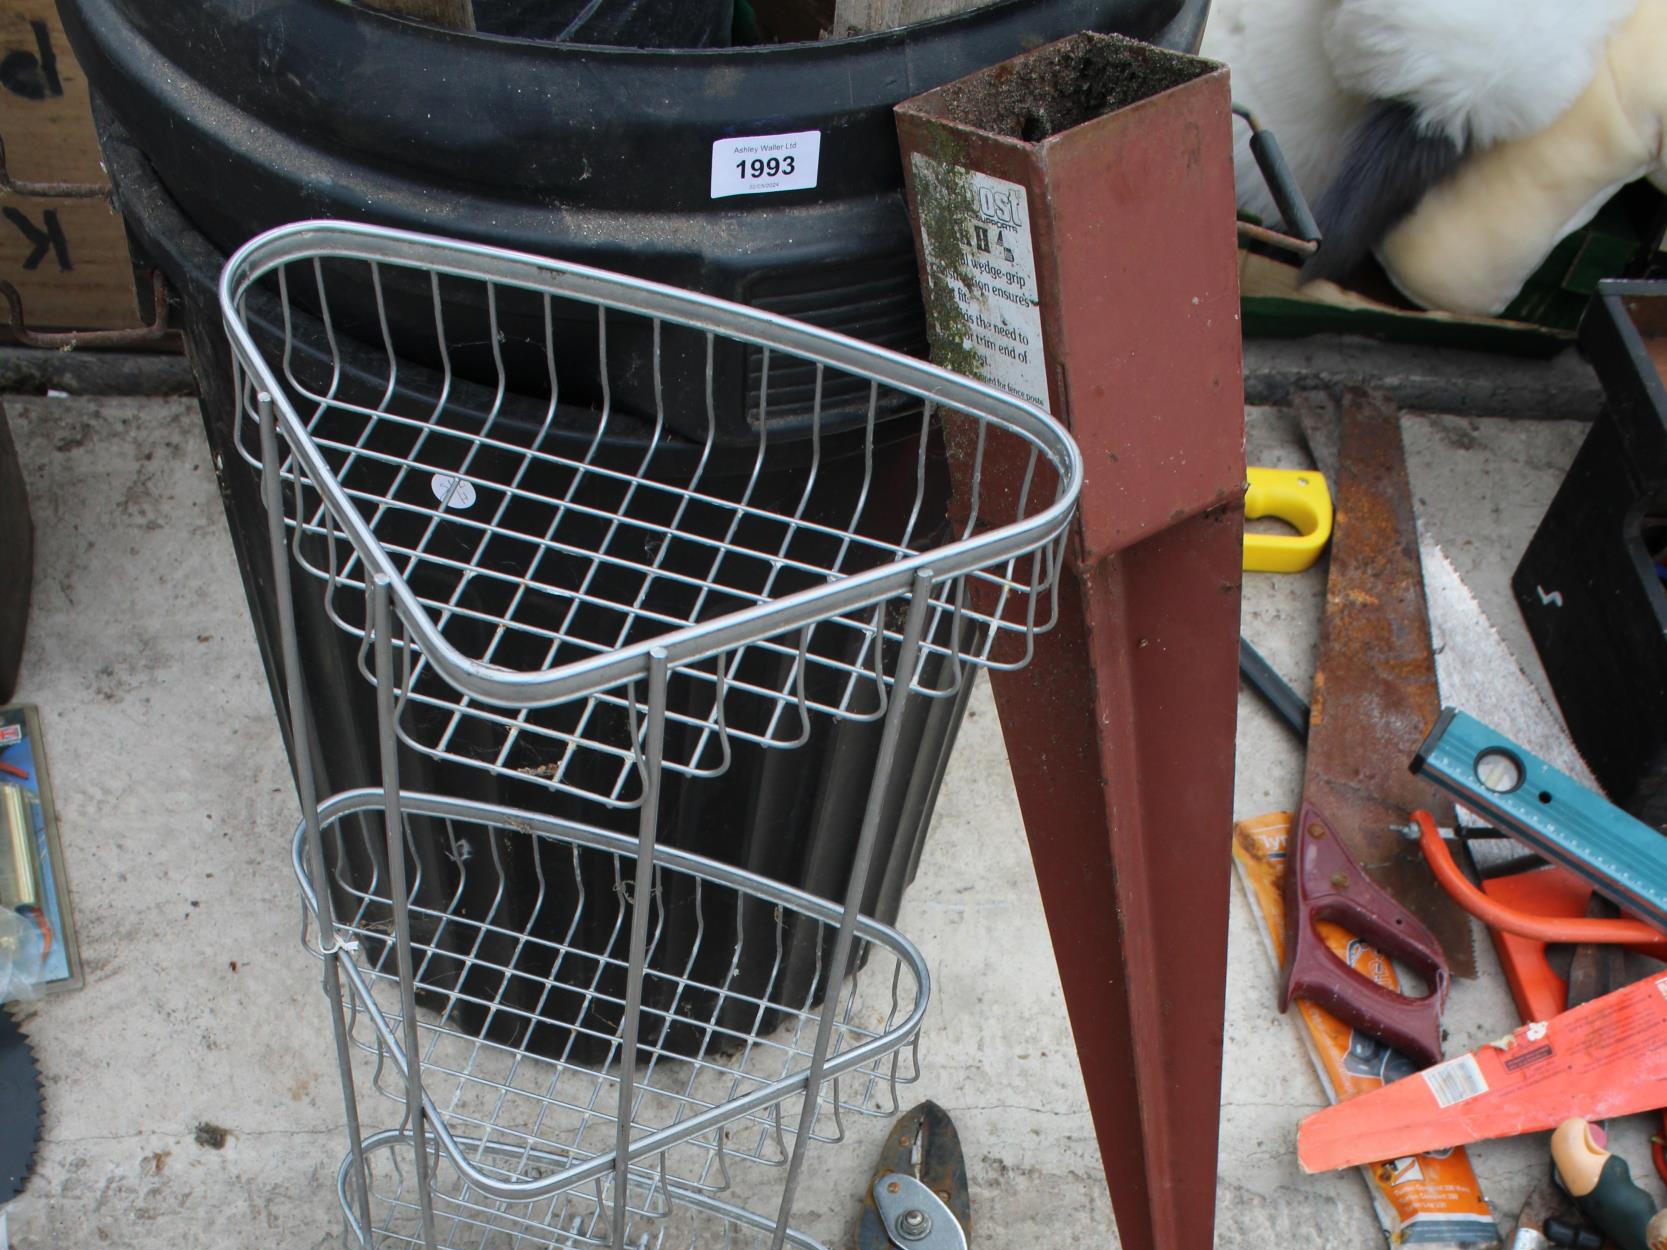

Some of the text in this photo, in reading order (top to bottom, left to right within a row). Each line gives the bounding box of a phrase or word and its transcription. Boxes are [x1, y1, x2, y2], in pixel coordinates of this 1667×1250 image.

[734, 142, 797, 154] Ashley Waller Ltd
[736, 156, 795, 179] 1993
[971, 259, 1026, 289] wedge-grip
[975, 314, 993, 332] the
[993, 324, 1017, 342] need
[1018, 332, 1029, 346] to
[975, 333, 996, 352] trim
[999, 346, 1016, 360] end
[1018, 350, 1028, 365] of
